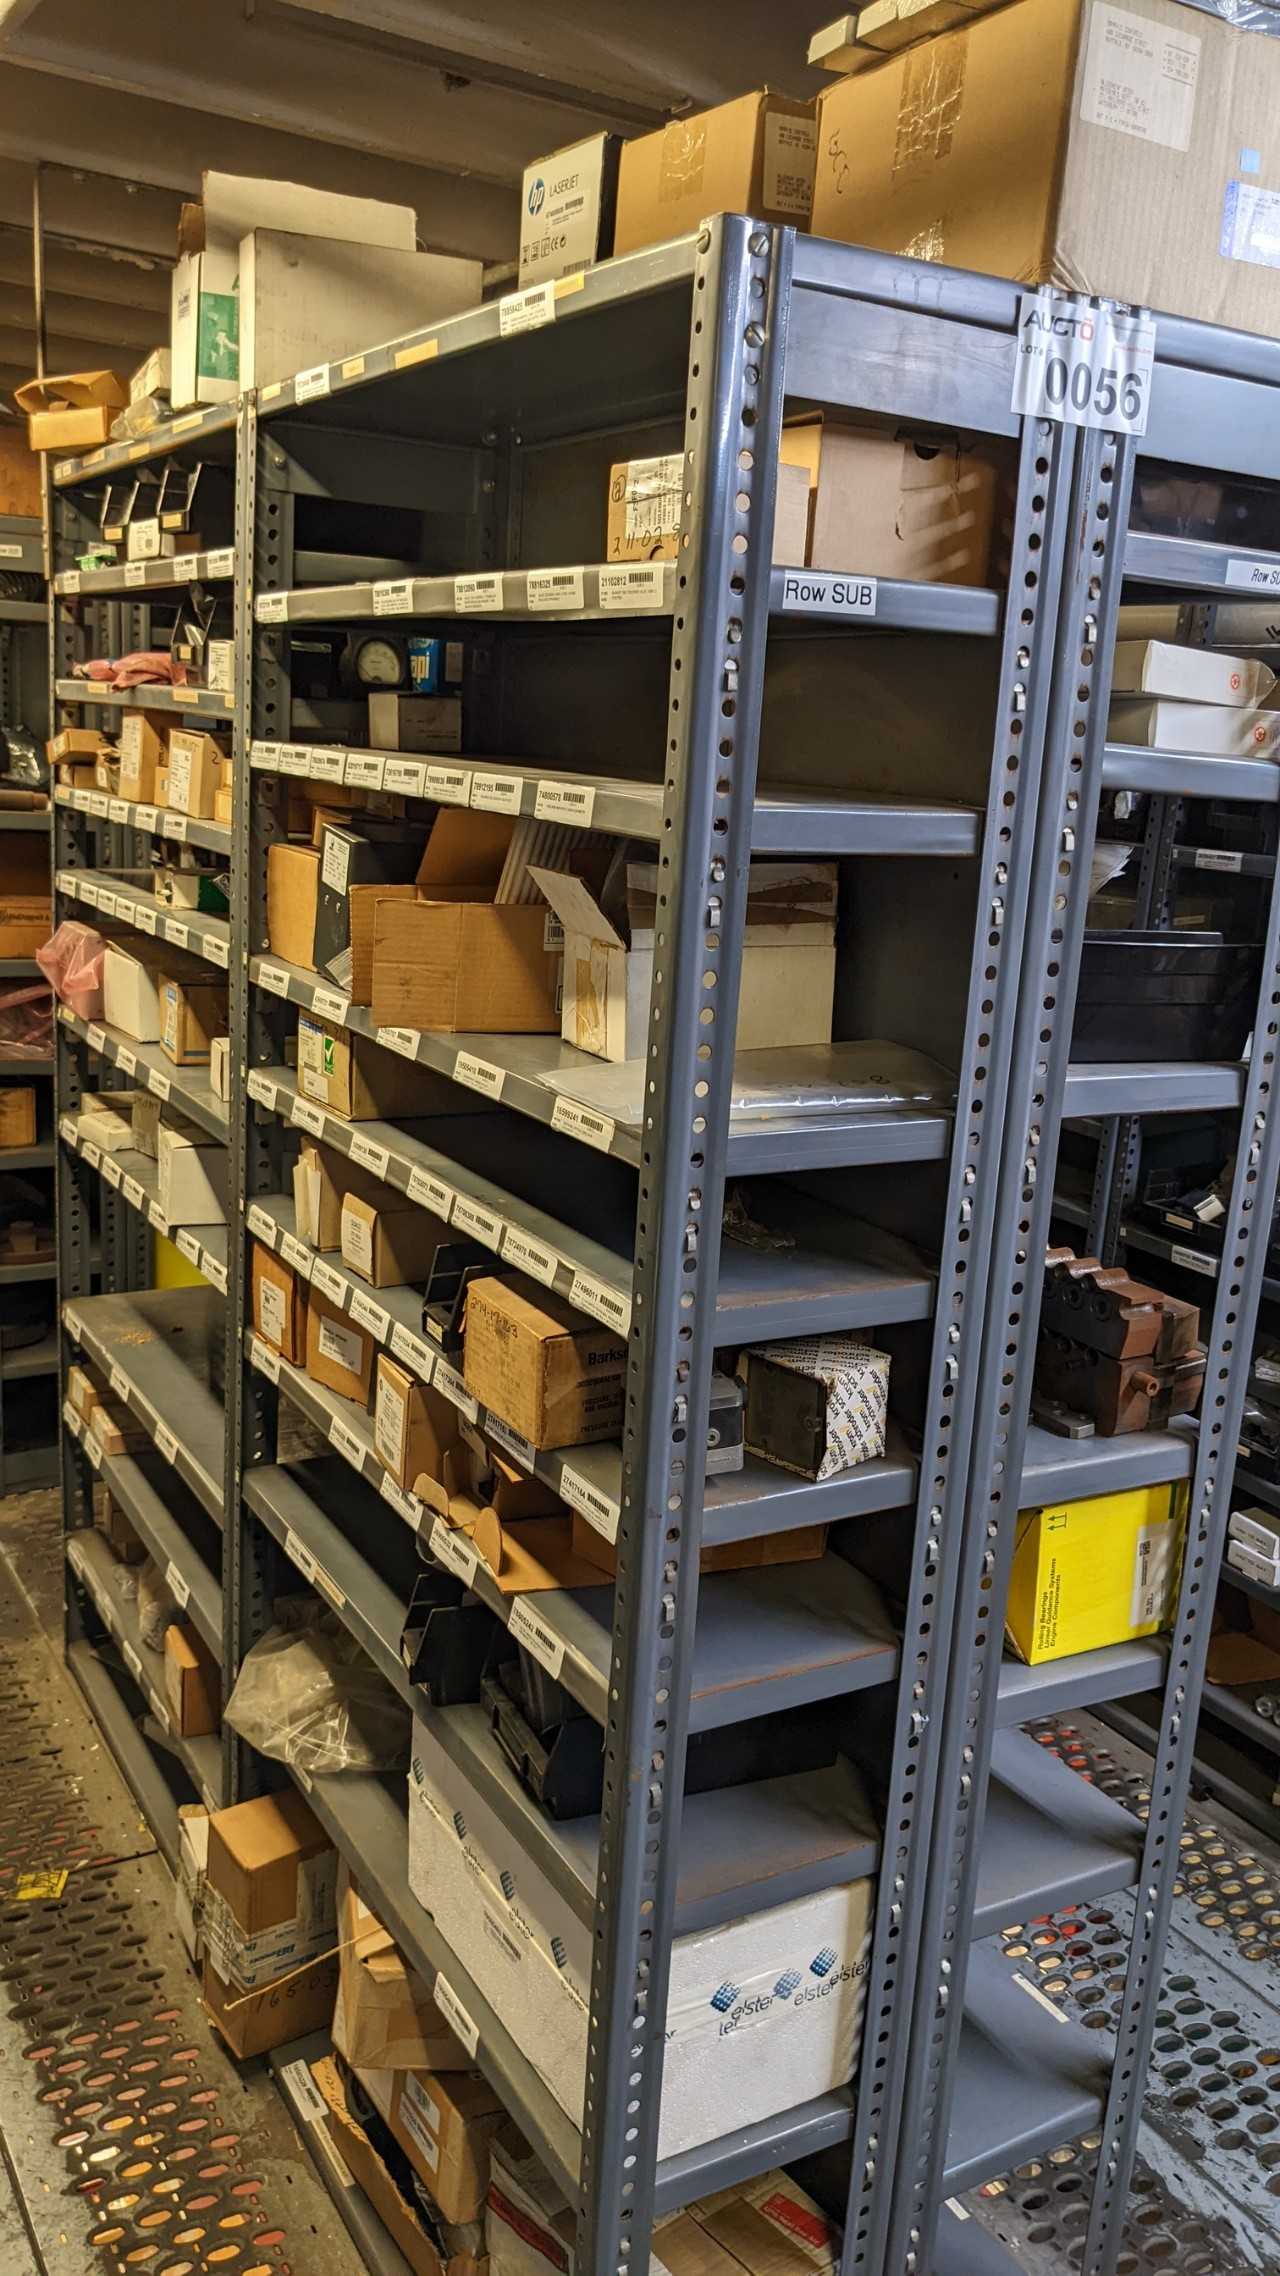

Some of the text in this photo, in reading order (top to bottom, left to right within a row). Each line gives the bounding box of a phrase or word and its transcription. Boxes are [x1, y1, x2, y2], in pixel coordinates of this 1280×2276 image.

[529, 180, 544, 216] hp
[549, 174, 579, 198] LASERJET
[1045, 357, 1142, 421] 0056
[1251, 568, 1269, 583] Row
[785, 579, 872, 606] Row SUB
[1053, 1574, 1061, 1620] Components
[830, 1960, 870, 1986] elster
[731, 1994, 775, 2022] elster
